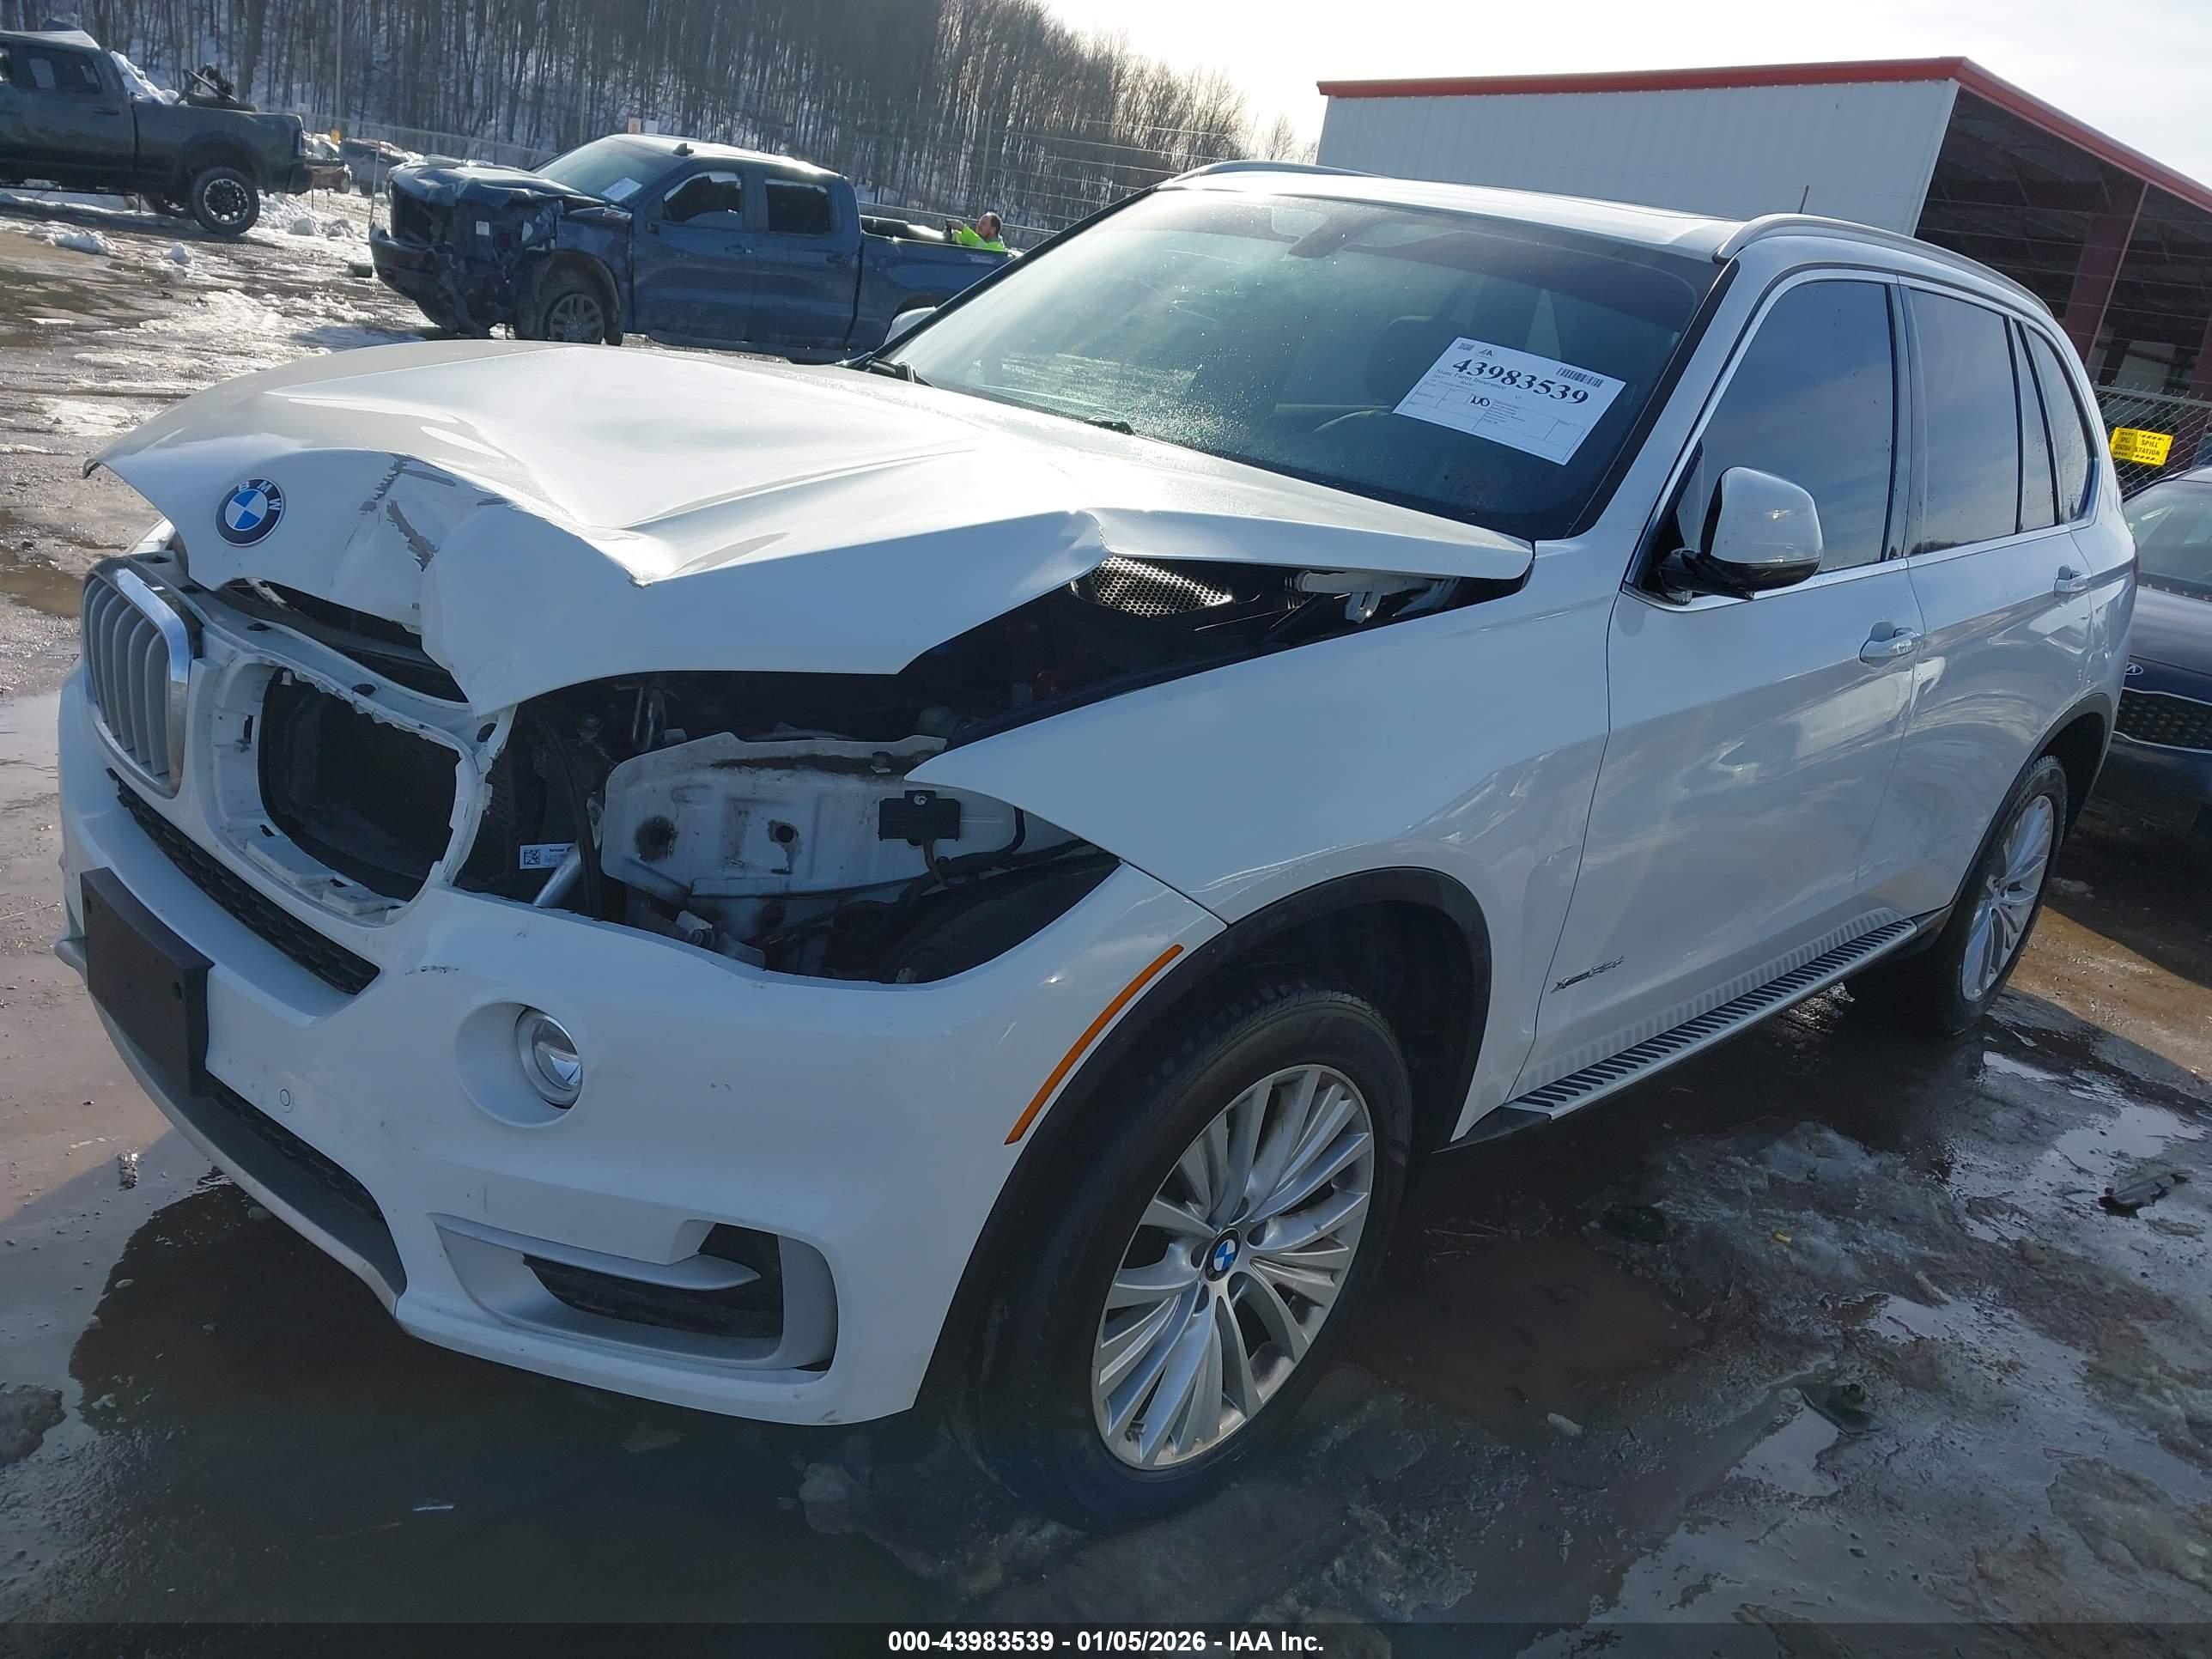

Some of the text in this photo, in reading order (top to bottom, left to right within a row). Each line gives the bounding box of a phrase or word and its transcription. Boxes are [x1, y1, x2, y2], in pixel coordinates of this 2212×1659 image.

[1452, 357, 1589, 404] 43983539
[1454, 372, 1473, 383] Farm
[2141, 440, 2159, 448] SPILL
[2135, 447, 2160, 456] STATION
[238, 480, 282, 511] BMW
